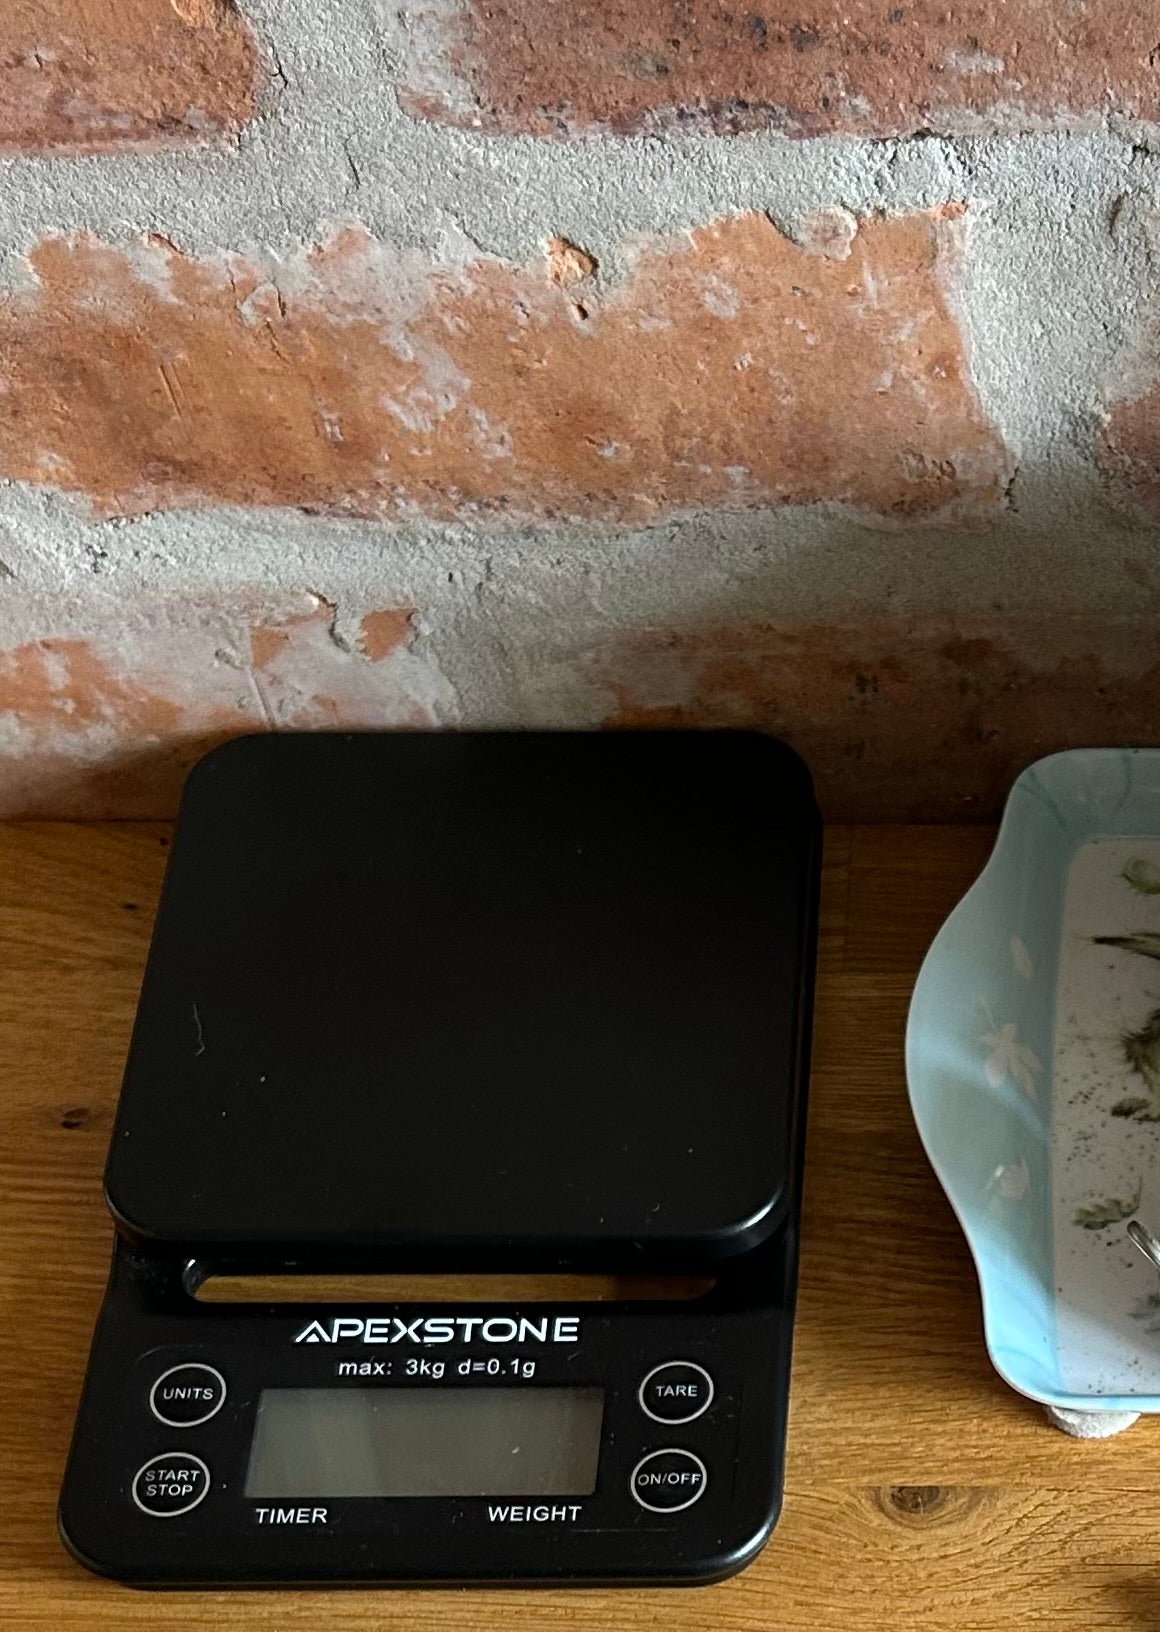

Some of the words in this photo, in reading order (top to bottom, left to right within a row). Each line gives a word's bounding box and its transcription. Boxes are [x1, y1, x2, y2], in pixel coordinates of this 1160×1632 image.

[295, 1317, 580, 1344] APEXSTONE
[338, 1360, 392, 1376] max:
[405, 1359, 446, 1379] 3kg
[458, 1358, 536, 1378] d=0.1g
[162, 1387, 214, 1400] UNITS
[656, 1385, 698, 1397] TARE
[145, 1470, 201, 1482] START
[637, 1472, 701, 1486] ON/OFF
[146, 1484, 194, 1497] STOP
[255, 1508, 328, 1524] TIMER
[487, 1505, 582, 1522] WEIGHT
